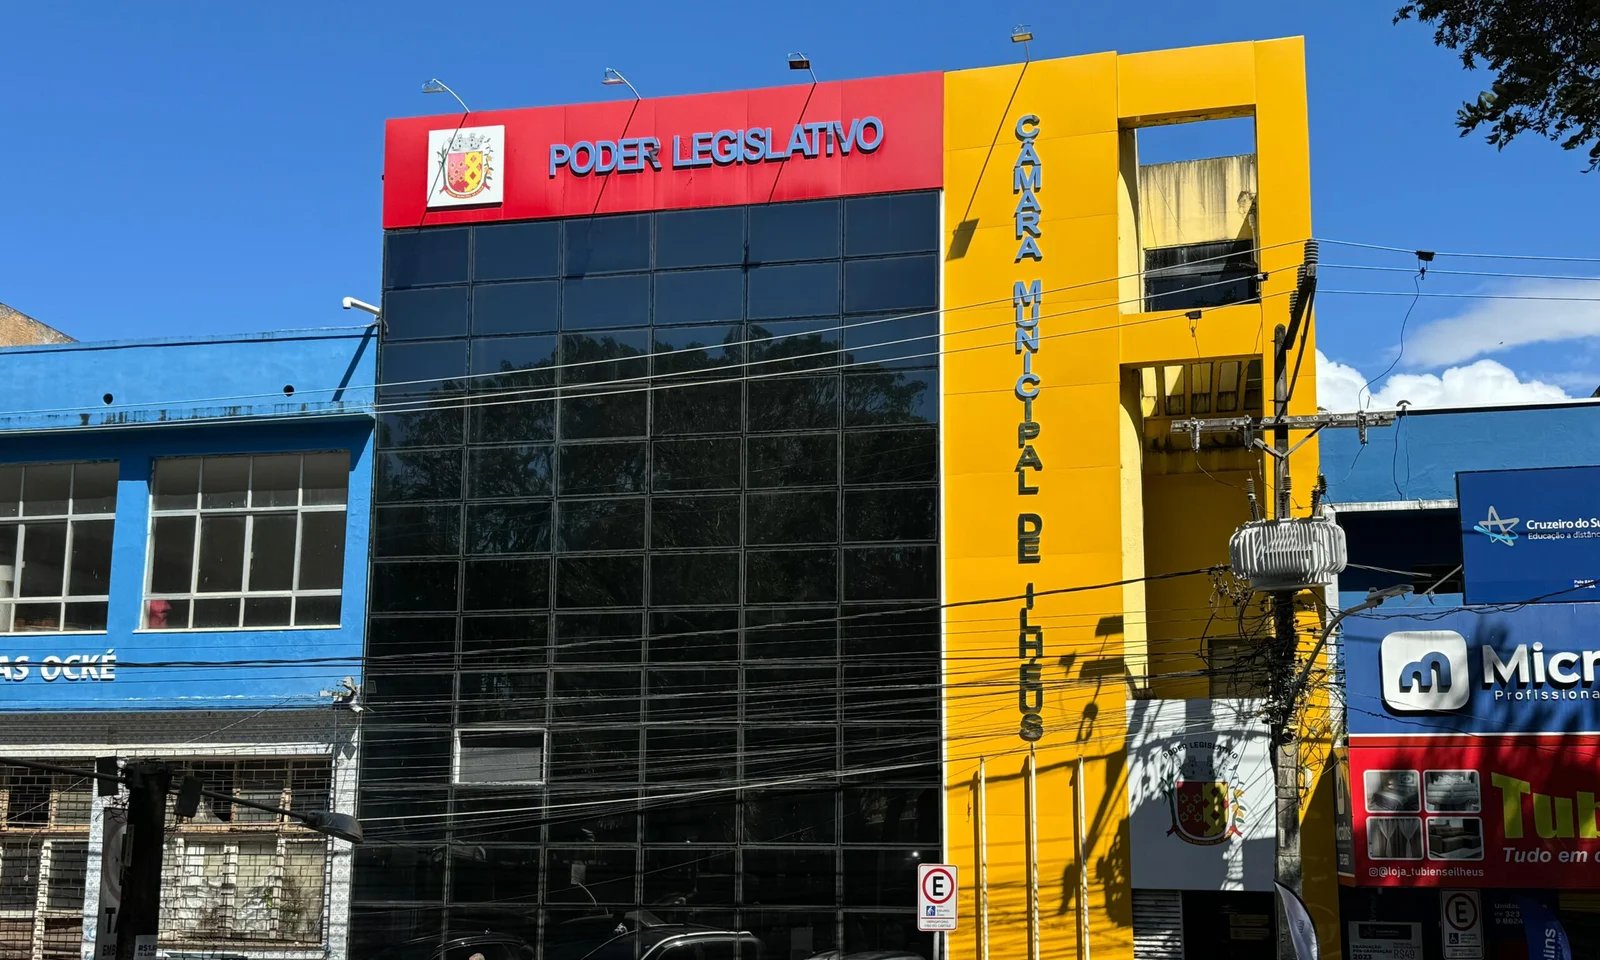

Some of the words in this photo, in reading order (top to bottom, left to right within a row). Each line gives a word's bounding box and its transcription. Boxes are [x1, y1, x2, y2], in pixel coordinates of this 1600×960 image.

[548, 137, 662, 179] PODER
[672, 115, 884, 171] LEGISLATIVO
[1013, 279, 1043, 496] MUNICIPAL
[1526, 519, 1573, 530] Cruzeiro
[1574, 518, 1590, 529] do
[1017, 513, 1043, 564] DE
[1528, 531, 1565, 541] Educação
[41, 648, 117, 681] OCKÉ
[1163, 743, 1188, 760] PODER
[1189, 741, 1239, 760] LEGISLATIVO
[1503, 847, 1552, 863] Tudo
[1558, 850, 1588, 863] em
[932, 875, 944, 896] E
[1455, 901, 1468, 923] E
